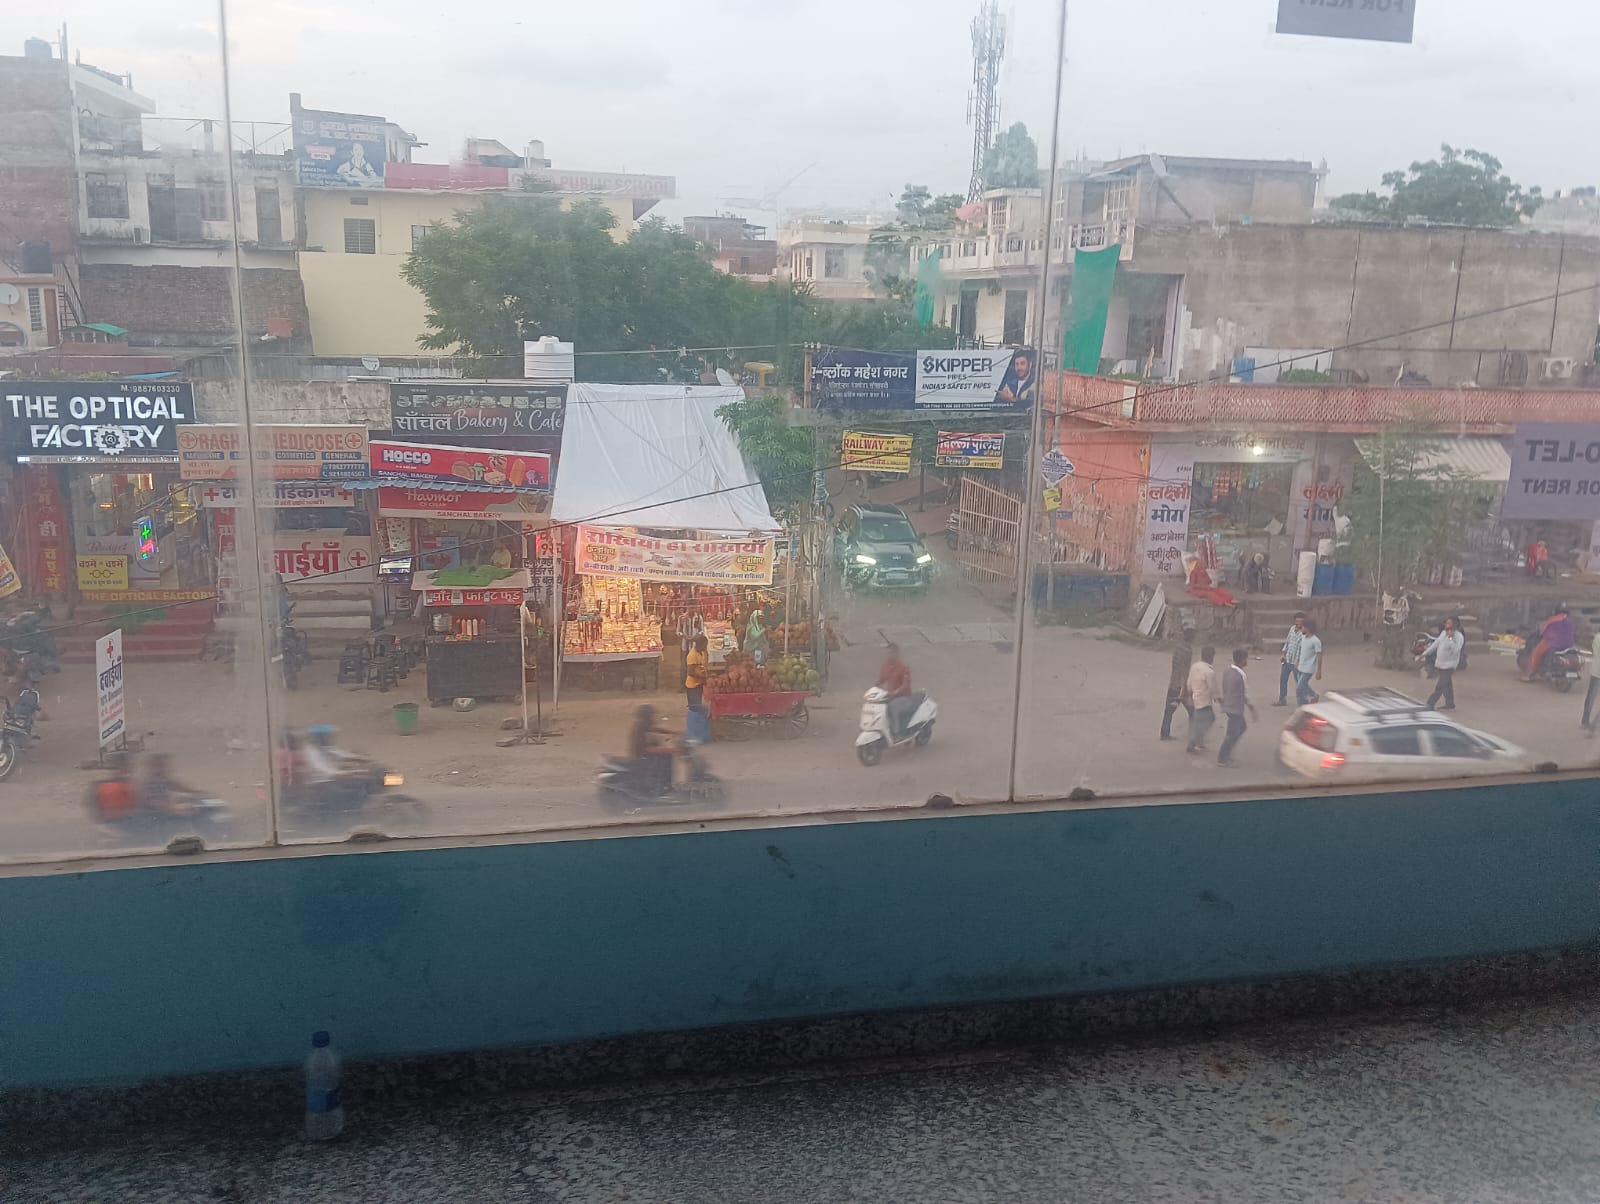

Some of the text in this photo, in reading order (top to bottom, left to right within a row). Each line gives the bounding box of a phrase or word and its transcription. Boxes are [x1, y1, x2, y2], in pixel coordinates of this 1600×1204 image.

[854, 363, 881, 379] महेश
[884, 366, 908, 379] नगर
[923, 357, 992, 374] SKIPPER
[922, 382, 991, 391] INDIA'S SAFEST PIPES
[6, 395, 185, 420] THE OPTICAL
[453, 409, 508, 434] Bakery
[513, 410, 525, 427] &
[31, 423, 164, 457] FACTORY
[199, 432, 262, 453] RAGH
[844, 439, 884, 450] RAILWAY
[326, 453, 357, 461] GENERAL
[383, 449, 432, 465] HOCCO
[378, 470, 410, 480] SANCHAL
[266, 542, 341, 577] वाईयाँ
[111, 592, 161, 600] OPTICAL
[163, 591, 216, 600] FACTORY
